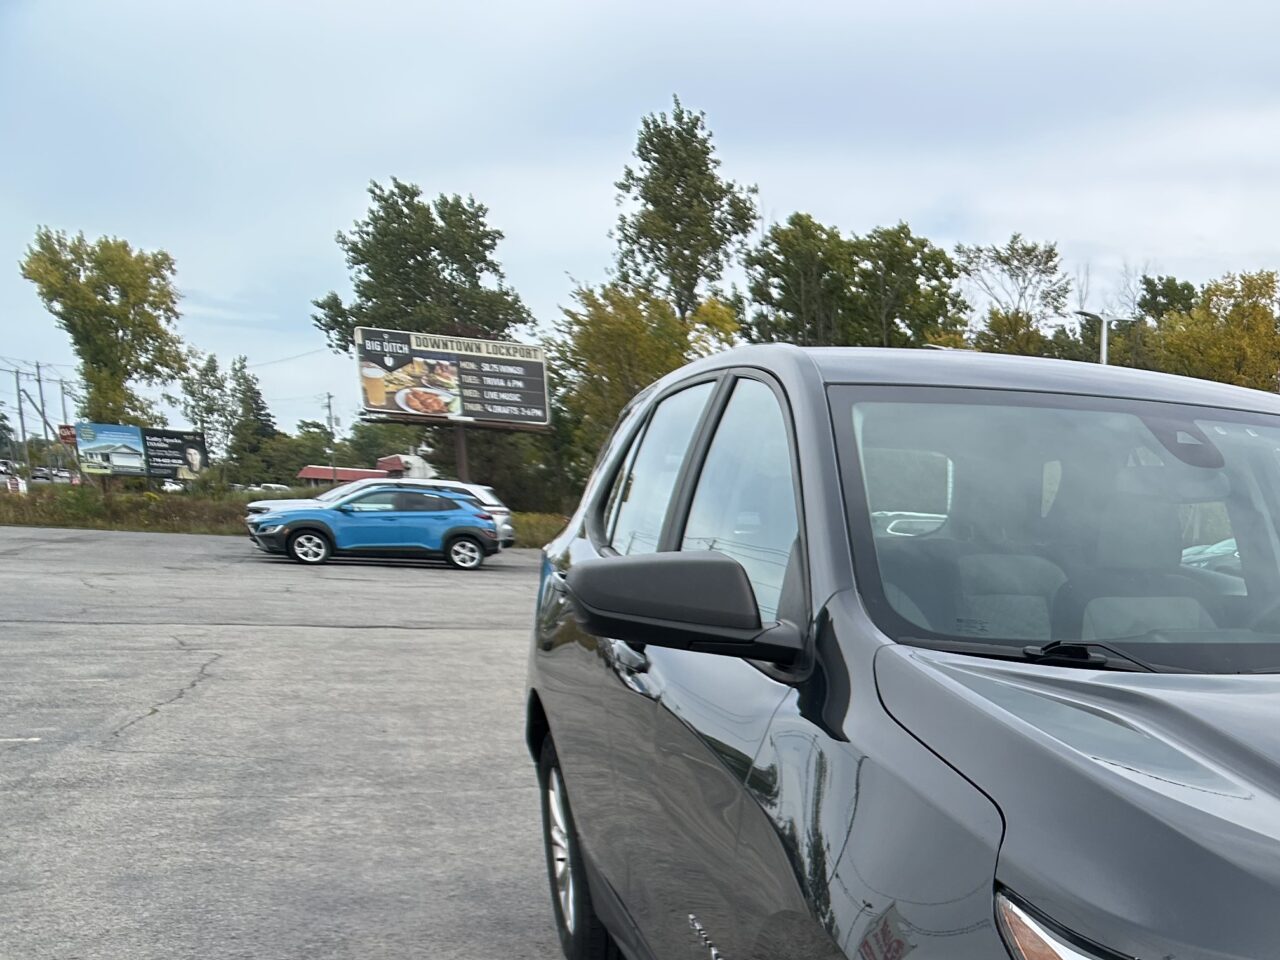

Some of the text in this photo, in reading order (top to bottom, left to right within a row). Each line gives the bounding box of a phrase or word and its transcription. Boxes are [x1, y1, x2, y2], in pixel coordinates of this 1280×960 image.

[365, 340, 409, 354] BIG DITCH
[415, 336, 538, 359] DOWNTOWN LOCKPORT
